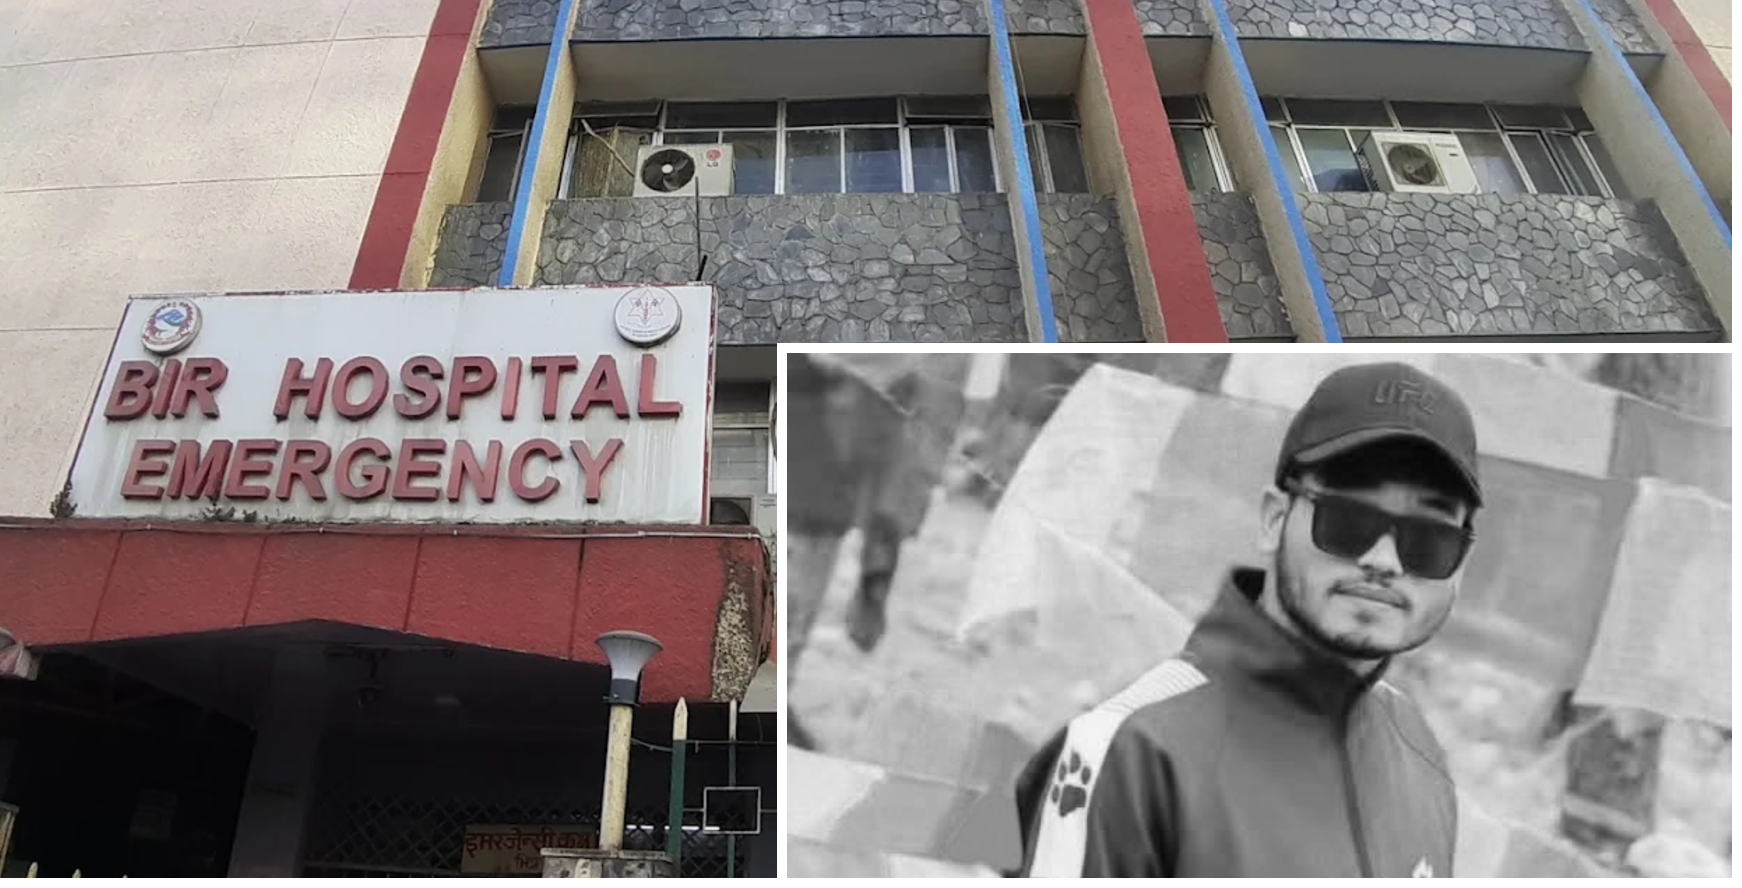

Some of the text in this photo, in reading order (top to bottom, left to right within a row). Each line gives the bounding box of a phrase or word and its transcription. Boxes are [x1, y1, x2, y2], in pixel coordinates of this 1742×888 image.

[104, 353, 684, 421] BIR HOSPITAL
[121, 437, 624, 504] EMERGENCY
